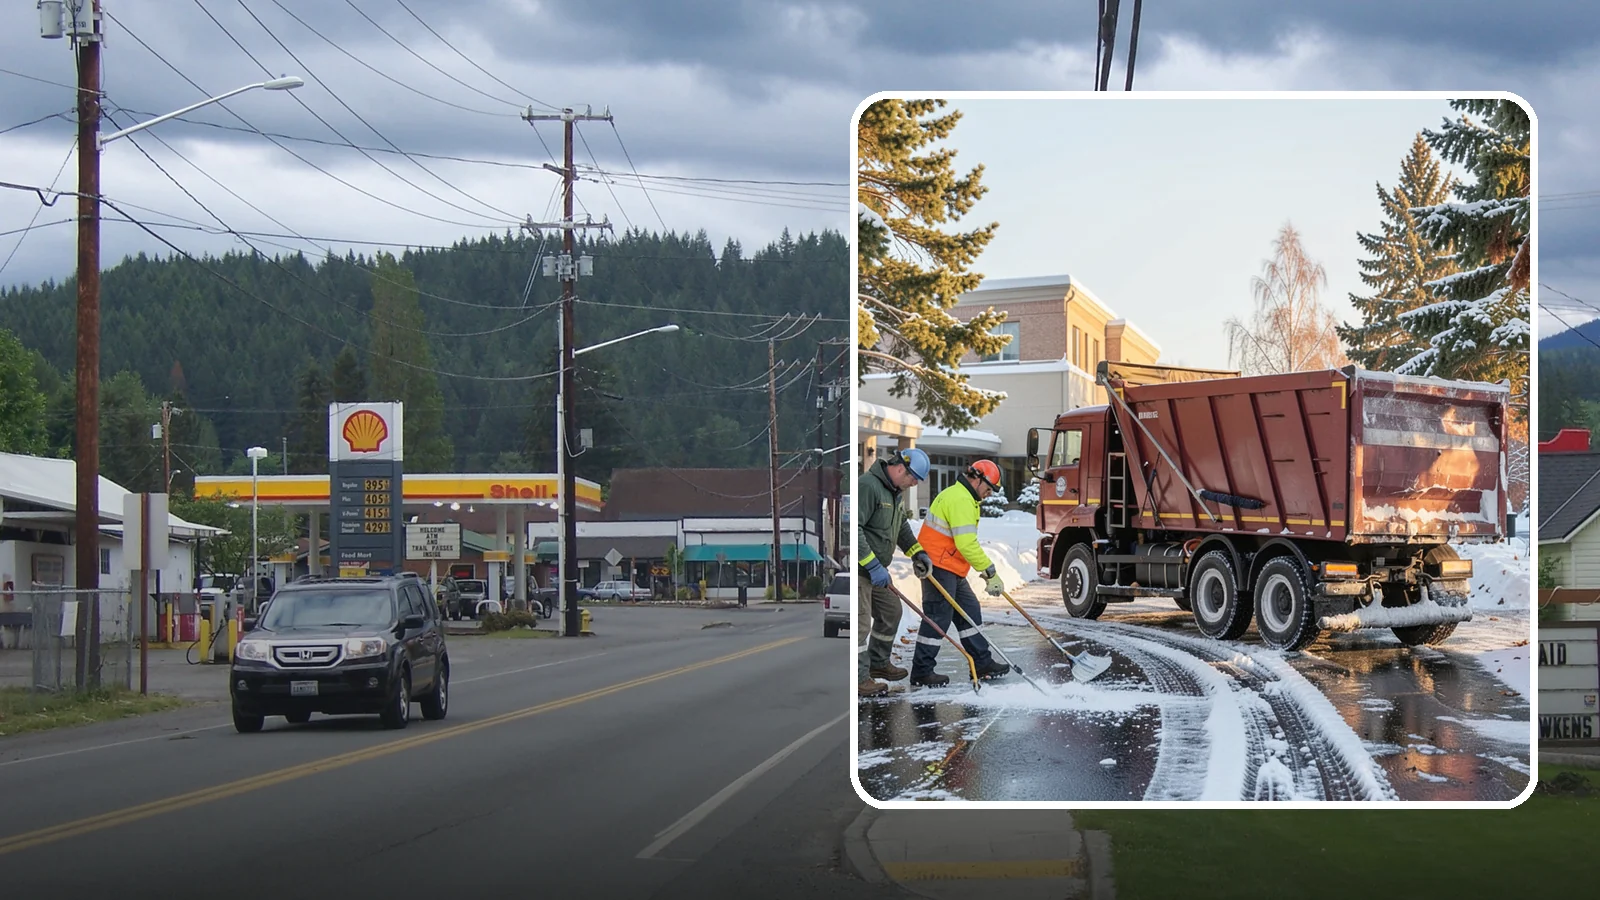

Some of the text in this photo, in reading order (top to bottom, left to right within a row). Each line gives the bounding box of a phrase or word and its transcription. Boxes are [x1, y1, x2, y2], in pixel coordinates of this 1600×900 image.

[365, 480, 383, 490] 395
[490, 484, 547, 499] Shell
[365, 494, 383, 504] 405
[365, 508, 383, 518] 415
[366, 522, 383, 532] 429
